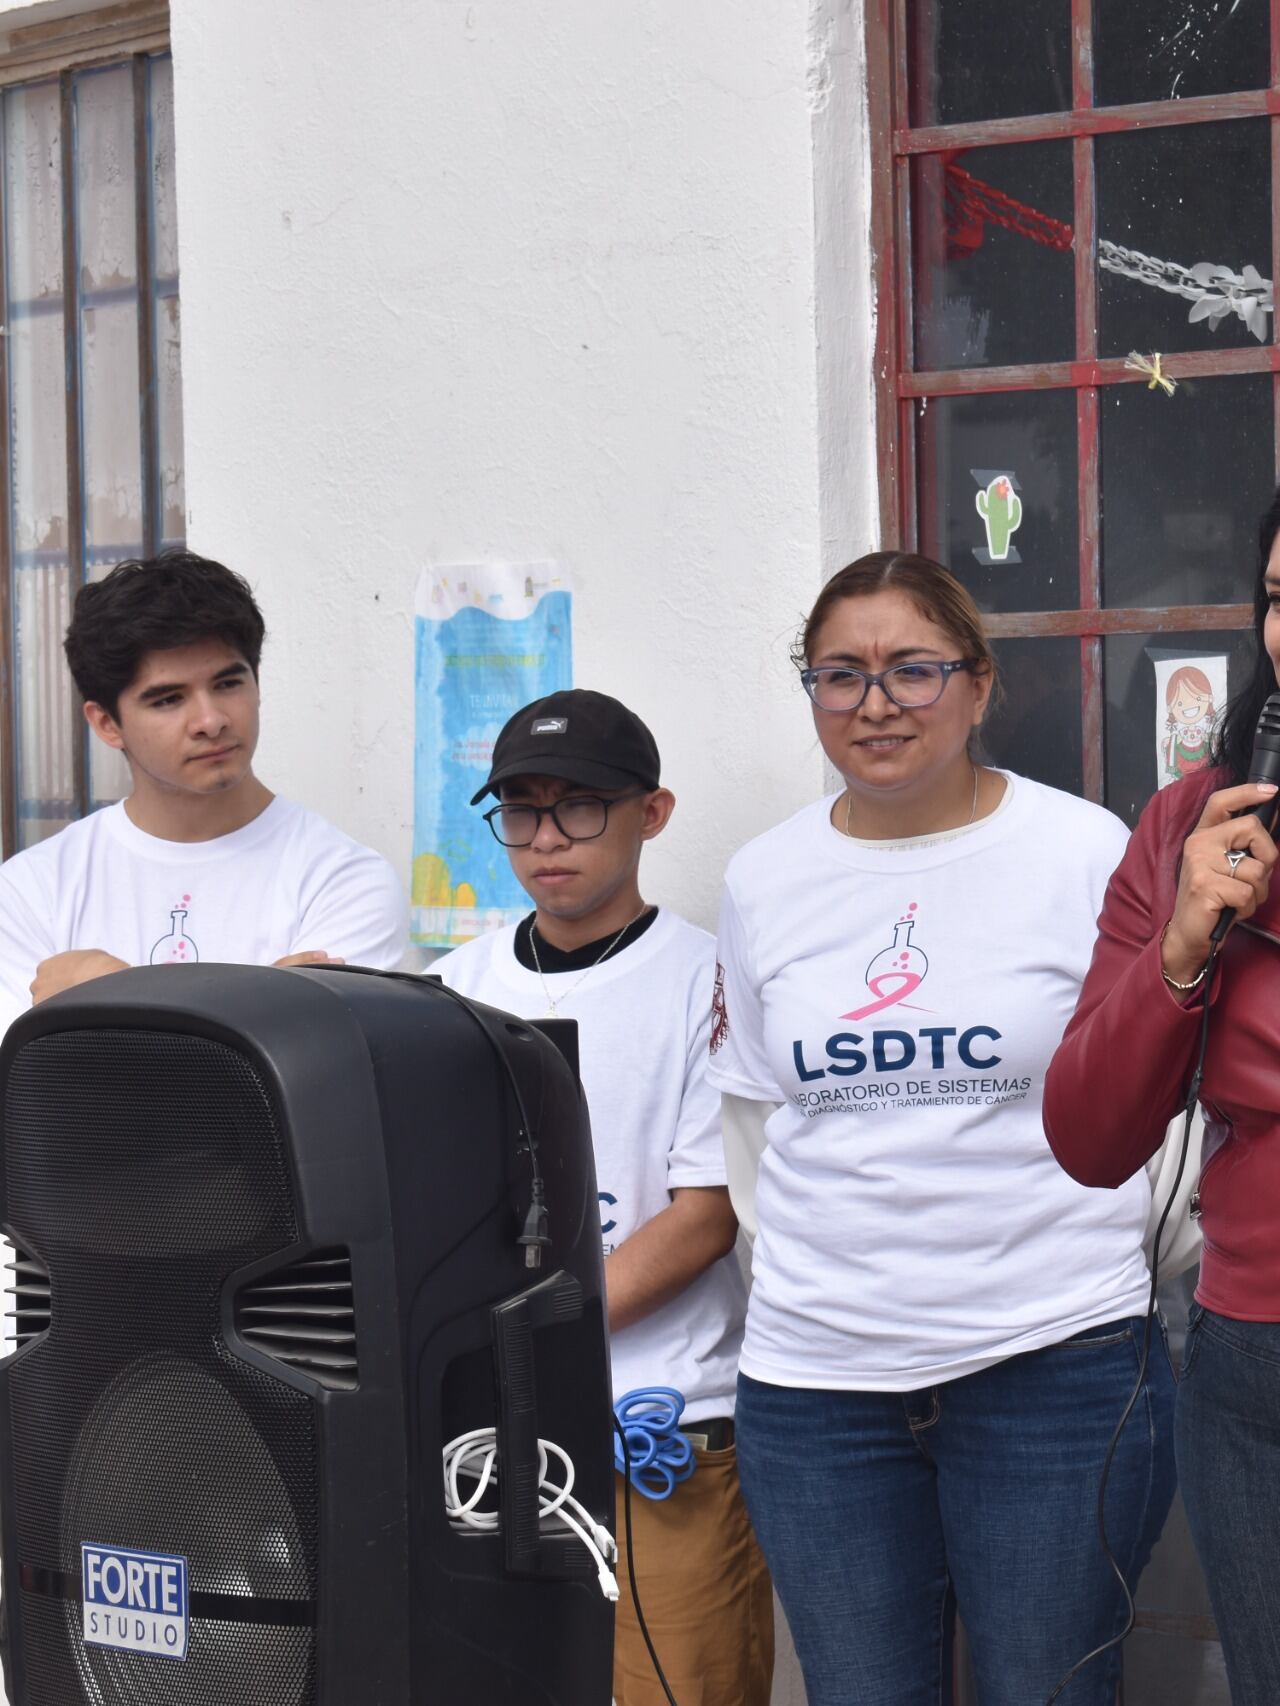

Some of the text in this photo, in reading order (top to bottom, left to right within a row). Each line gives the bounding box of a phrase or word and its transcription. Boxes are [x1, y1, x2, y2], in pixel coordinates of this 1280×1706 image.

[793, 1025, 1003, 1082] LSDTC
[881, 1101, 889, 1110] Y
[891, 1096, 964, 1109] TRATAMIENTO
[967, 1096, 982, 1105] DE
[906, 1080, 932, 1095] DE
[938, 1077, 1032, 1094] SISTEMAS
[86, 1553, 178, 1613] FORTE
[90, 1612, 178, 1647] STUDIO
